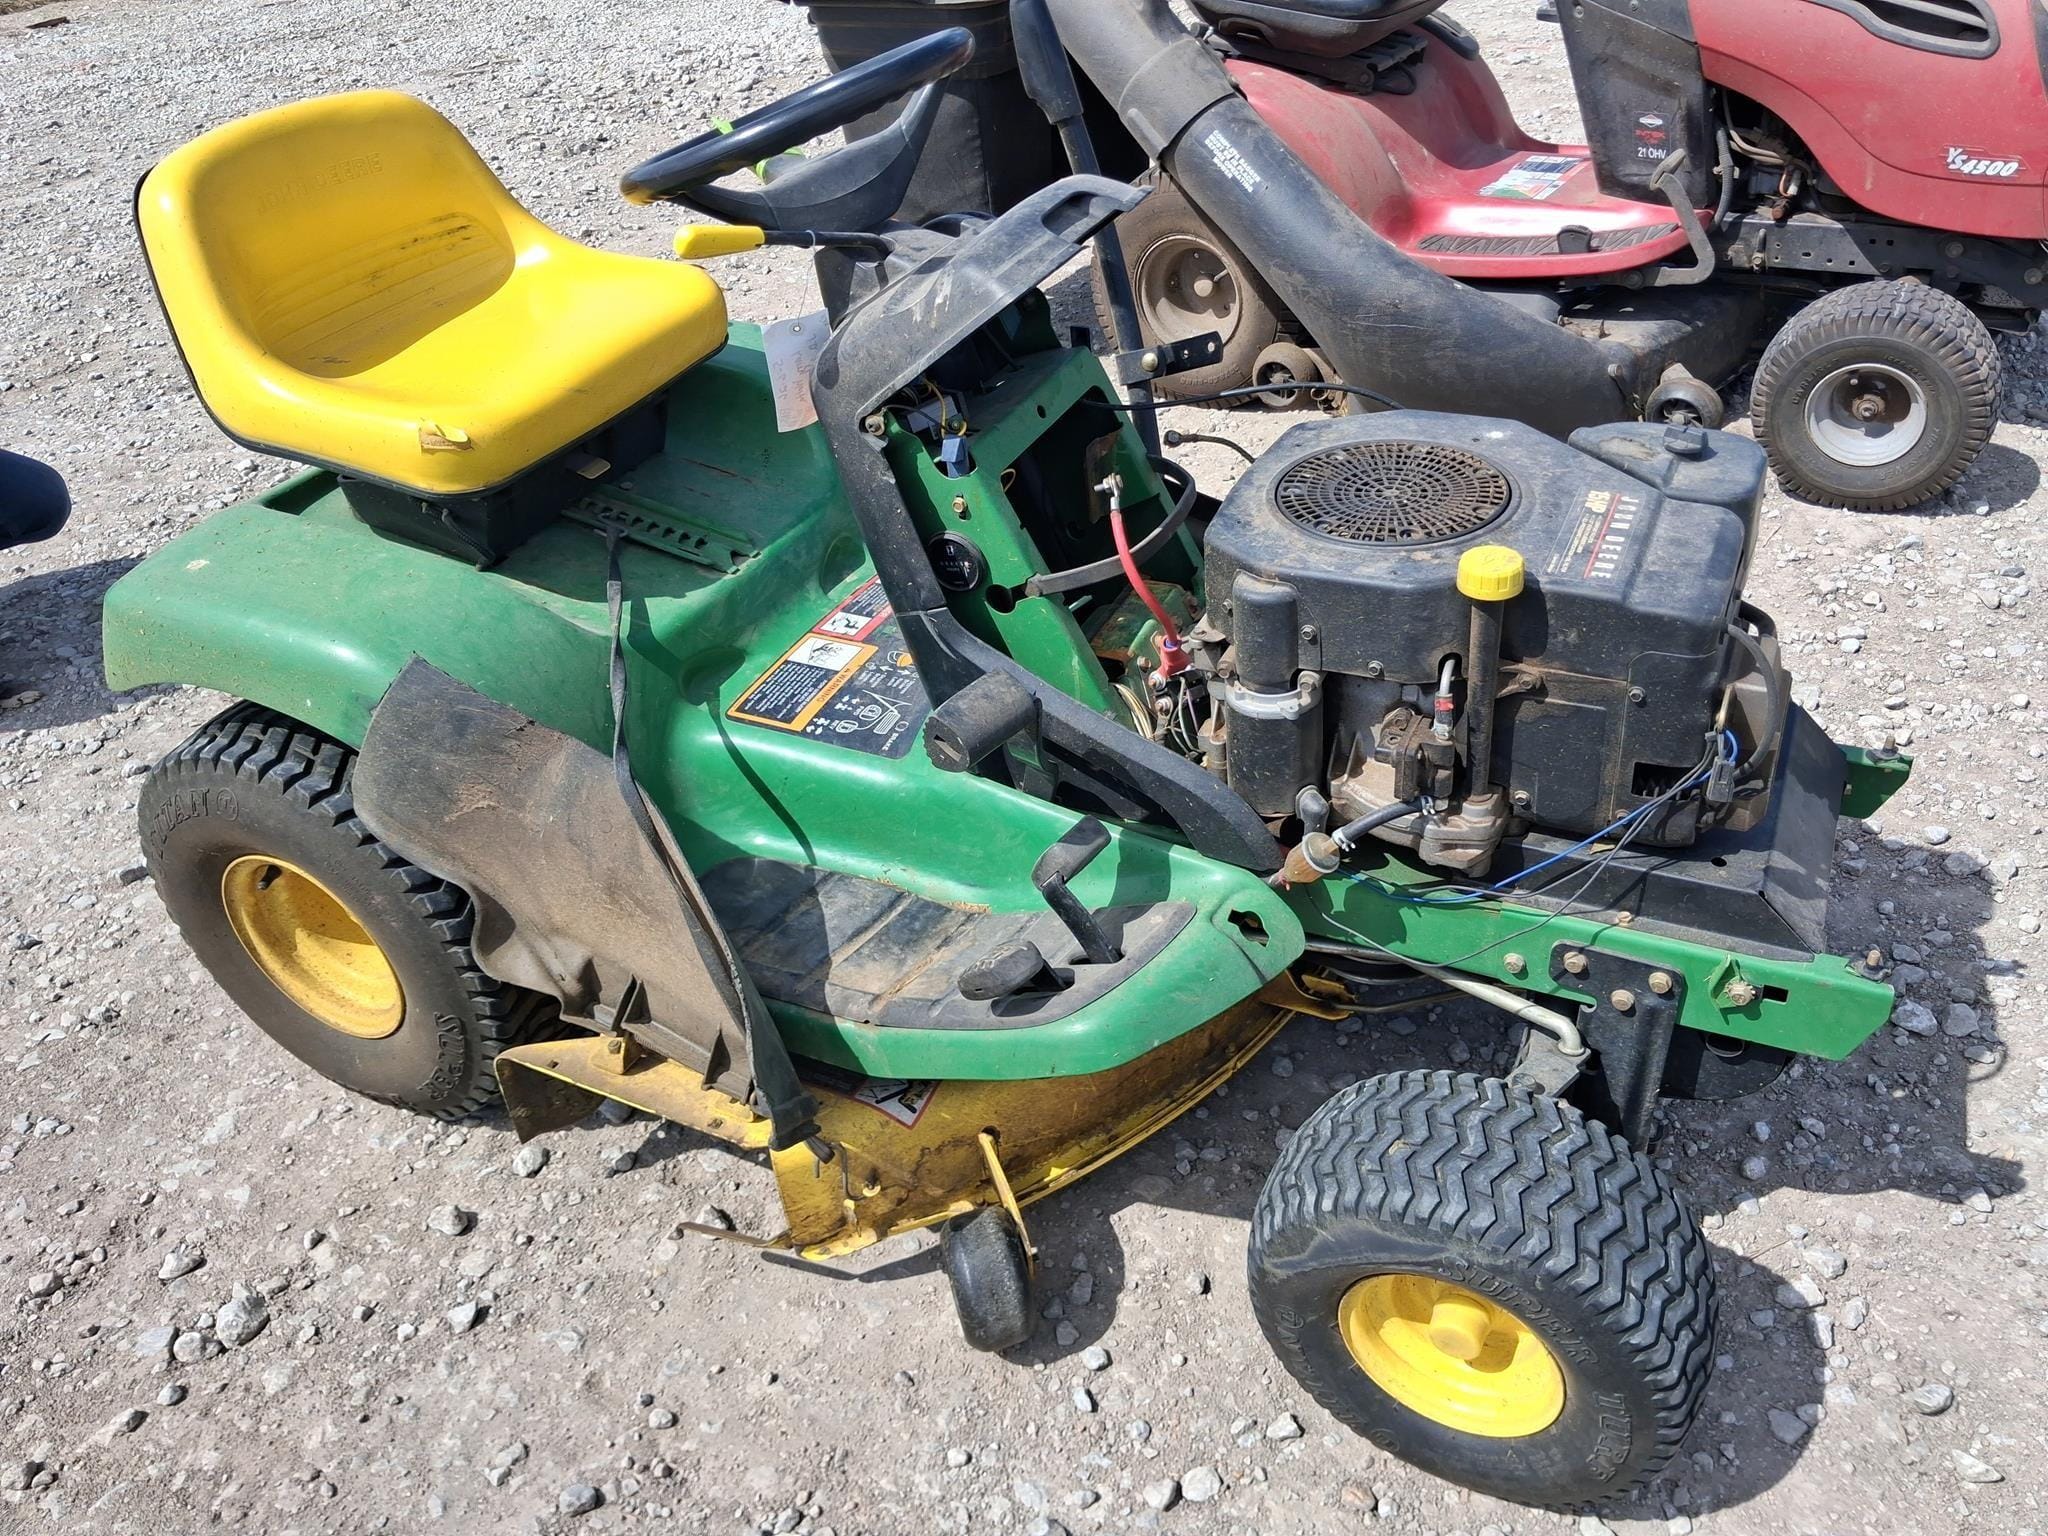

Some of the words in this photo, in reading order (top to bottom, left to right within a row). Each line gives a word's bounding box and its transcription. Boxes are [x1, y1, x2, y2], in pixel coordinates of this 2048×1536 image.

[1637, 147, 1647, 158] 21
[1647, 148, 1667, 160] OHV
[1946, 147, 2019, 177] YS4500
[314, 152, 384, 190] DEERE
[1224, 160, 1253, 193] OPERATING
[1237, 164, 1255, 185] PLACE
[1609, 496, 1640, 530] JOHN
[1589, 535, 1625, 579] DEERE
[816, 672, 847, 702] WARNING
[882, 732, 899, 751] BRAKE
[1437, 1254, 1601, 1367] SUPER
